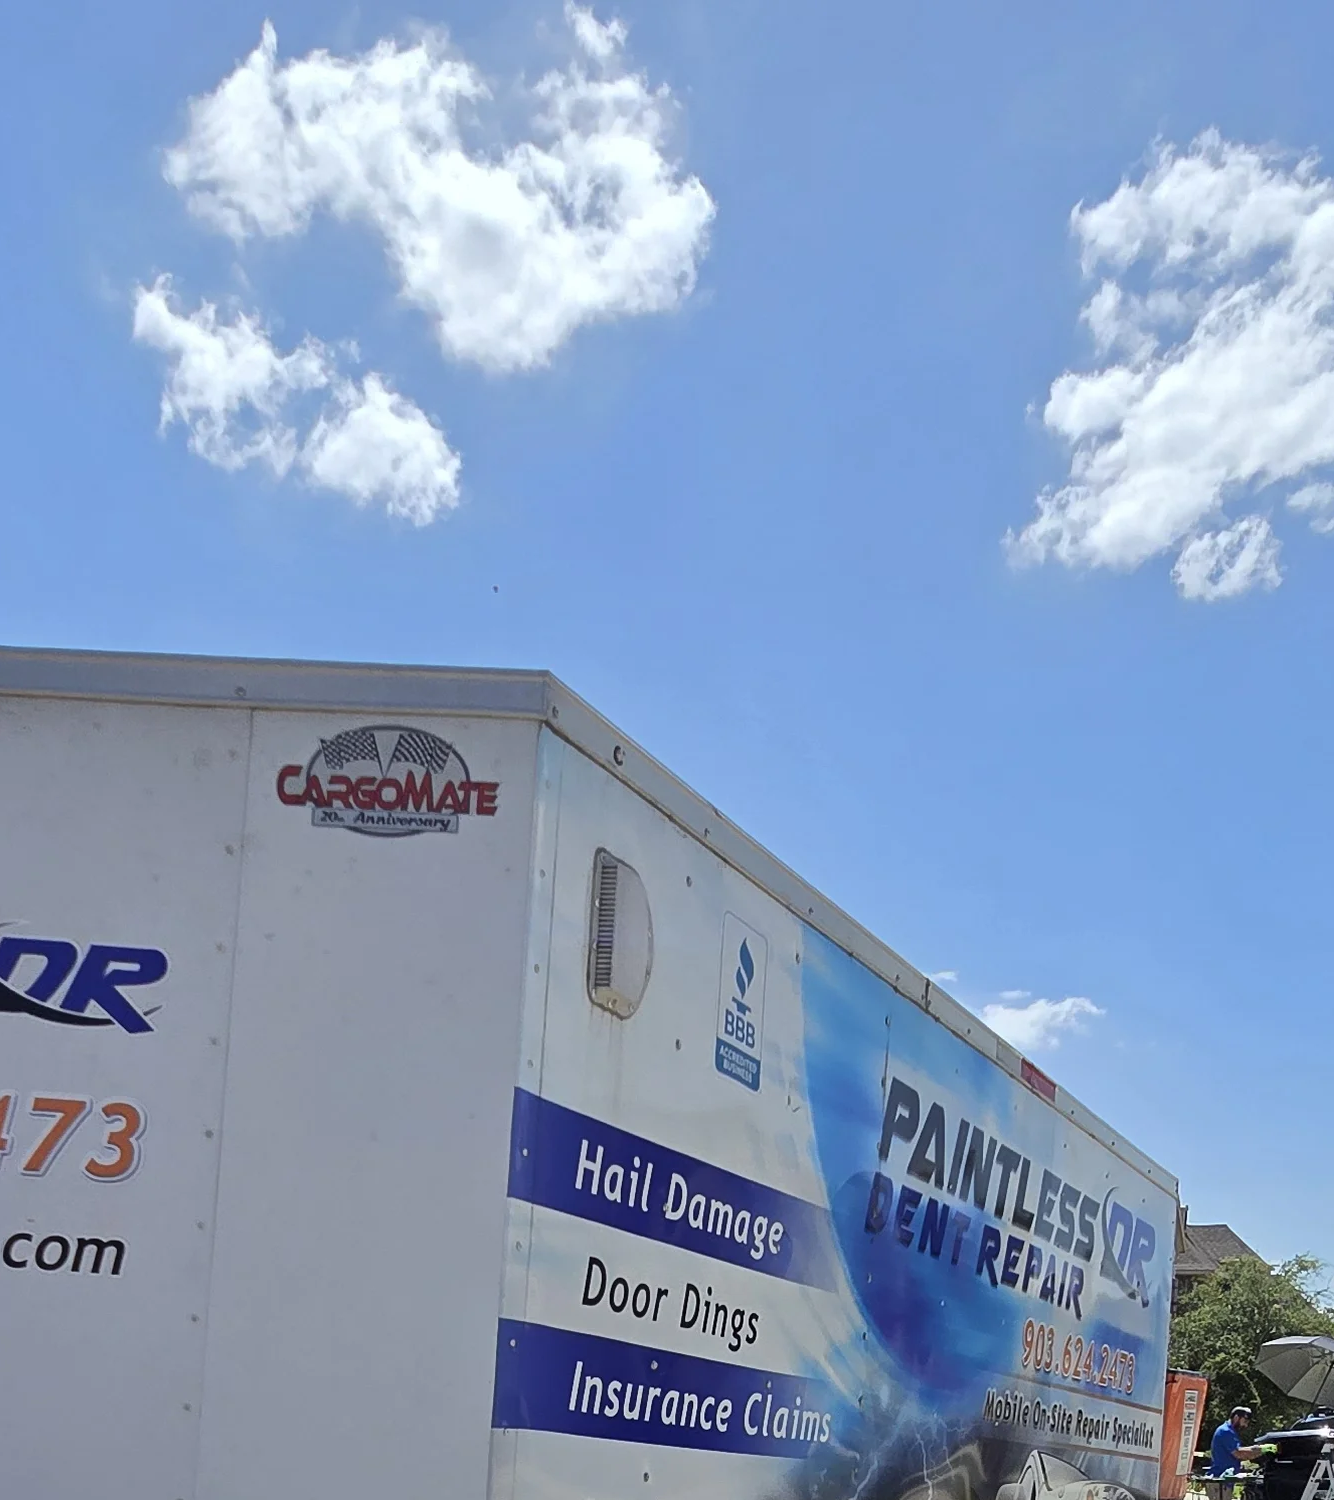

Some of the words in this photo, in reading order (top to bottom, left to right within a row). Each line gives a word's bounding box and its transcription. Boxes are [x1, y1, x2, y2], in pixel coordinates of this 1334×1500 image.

[276, 764, 500, 817] CARGOMATE
[354, 811, 452, 832] Anniversary
[724, 1008, 756, 1049] BBB
[574, 1139, 653, 1212] Hail
[665, 1172, 784, 1260] Damage
[878, 1076, 1100, 1262] PAINTLESS
[864, 1171, 972, 1265] DENT
[975, 1224, 1084, 1321] REPAIR
[581, 1256, 668, 1322] Door
[679, 1283, 760, 1352] Dings
[1021, 1316, 1137, 1395] 903.624.2473
[568, 1360, 733, 1433] Insurance
[743, 1390, 832, 1443] Claims
[983, 1391, 1030, 1427] Mobile
[1033, 1400, 1073, 1435] On-Site
[1075, 1409, 1110, 1445] Repair
[1112, 1416, 1155, 1449] Specialist
